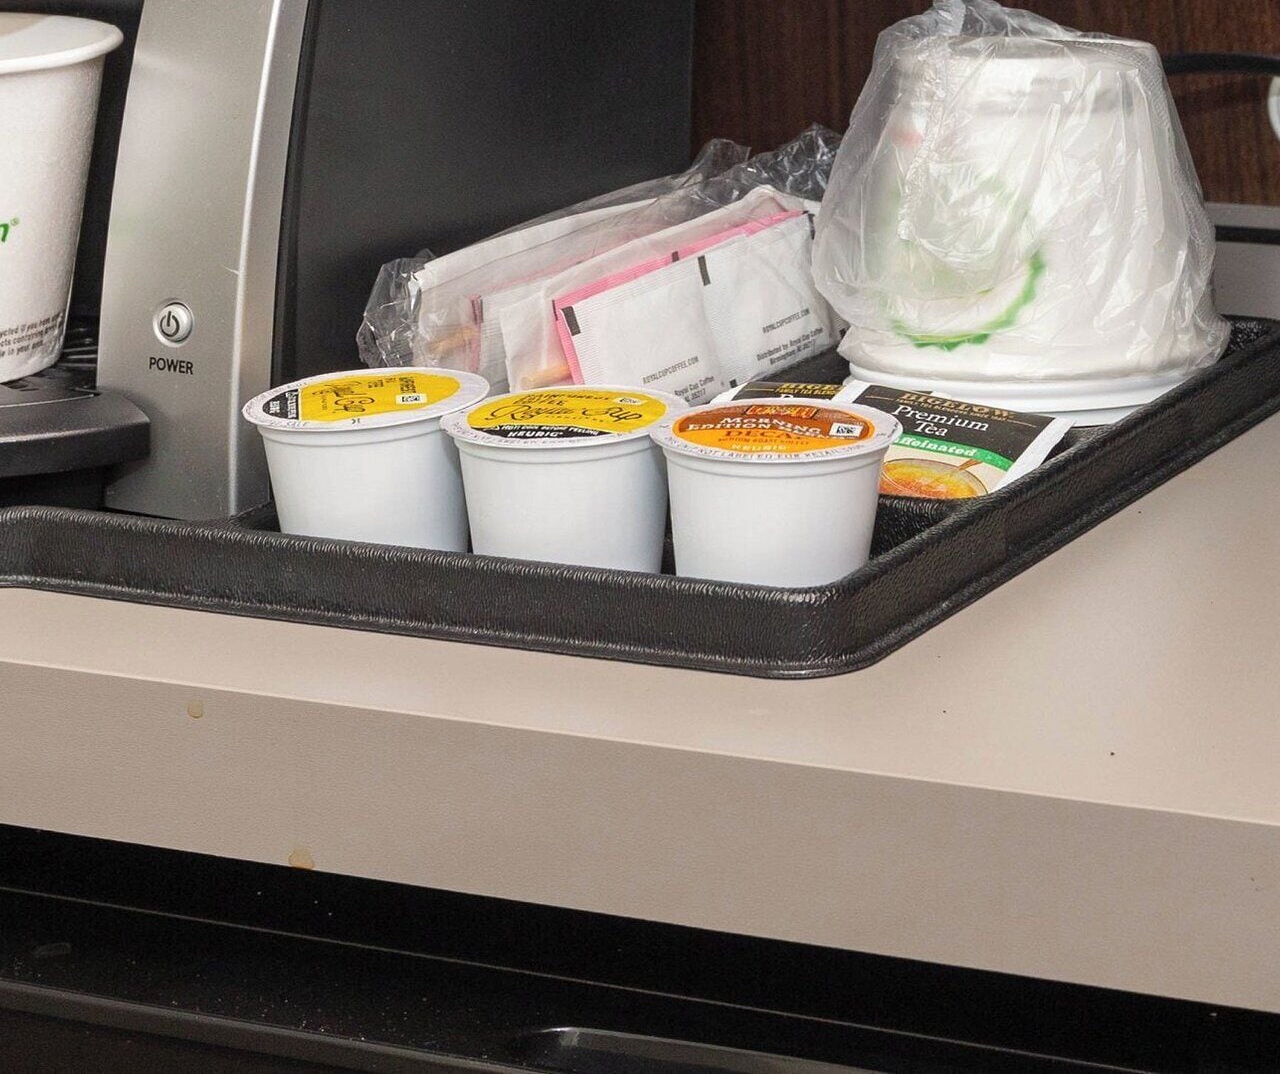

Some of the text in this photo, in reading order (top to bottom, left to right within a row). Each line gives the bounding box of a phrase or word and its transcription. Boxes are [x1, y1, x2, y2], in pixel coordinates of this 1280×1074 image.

[148, 356, 194, 375] POWER
[891, 405, 989, 432] Premium
[914, 420, 949, 437] Tea
